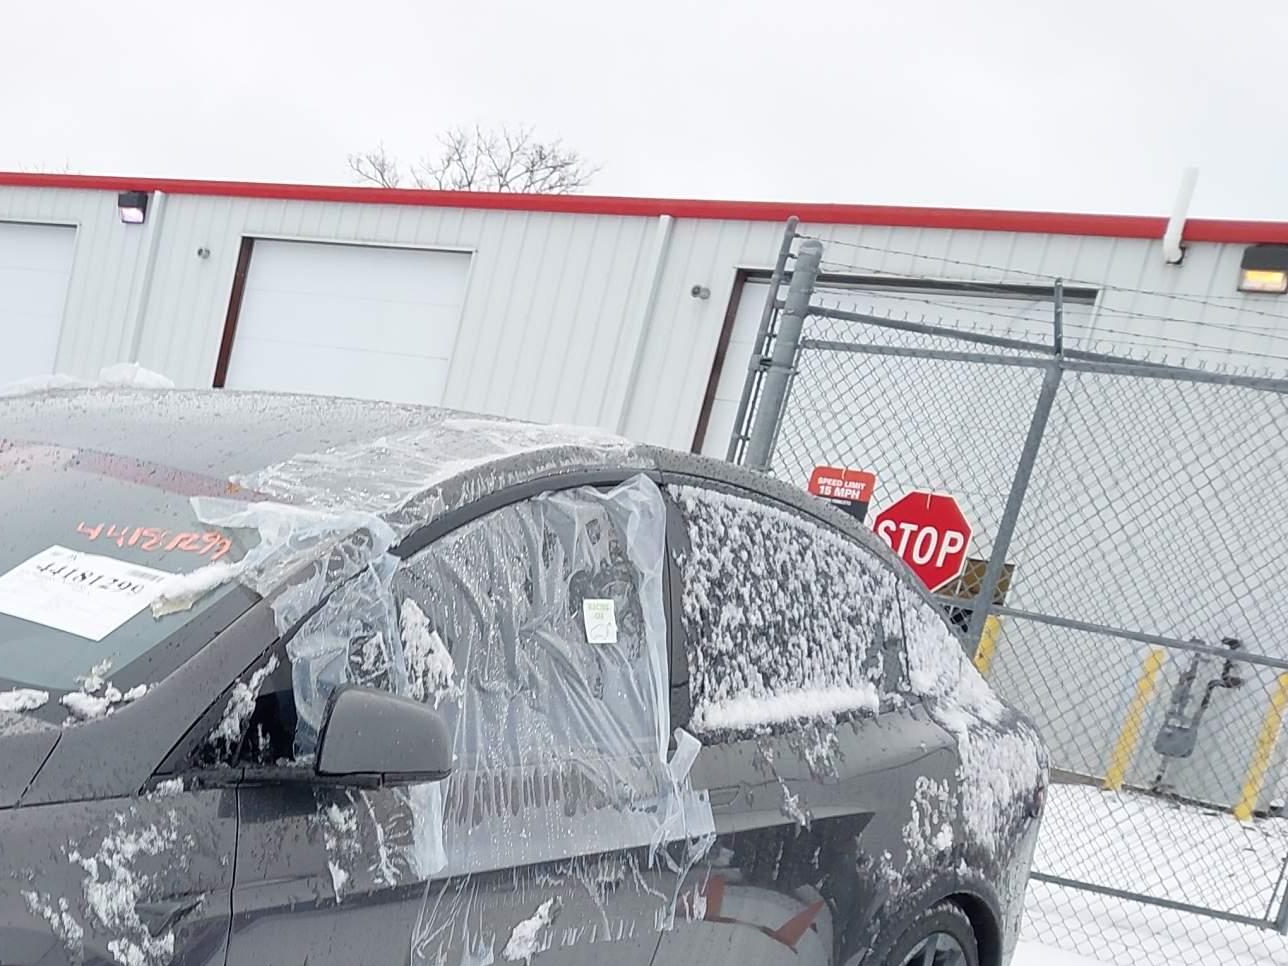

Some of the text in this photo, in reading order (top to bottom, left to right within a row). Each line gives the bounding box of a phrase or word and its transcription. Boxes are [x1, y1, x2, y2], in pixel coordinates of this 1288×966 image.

[817, 477, 866, 490] SPEED LIMIT
[818, 485, 861, 499] 15 MPH
[877, 520, 964, 568] STOP
